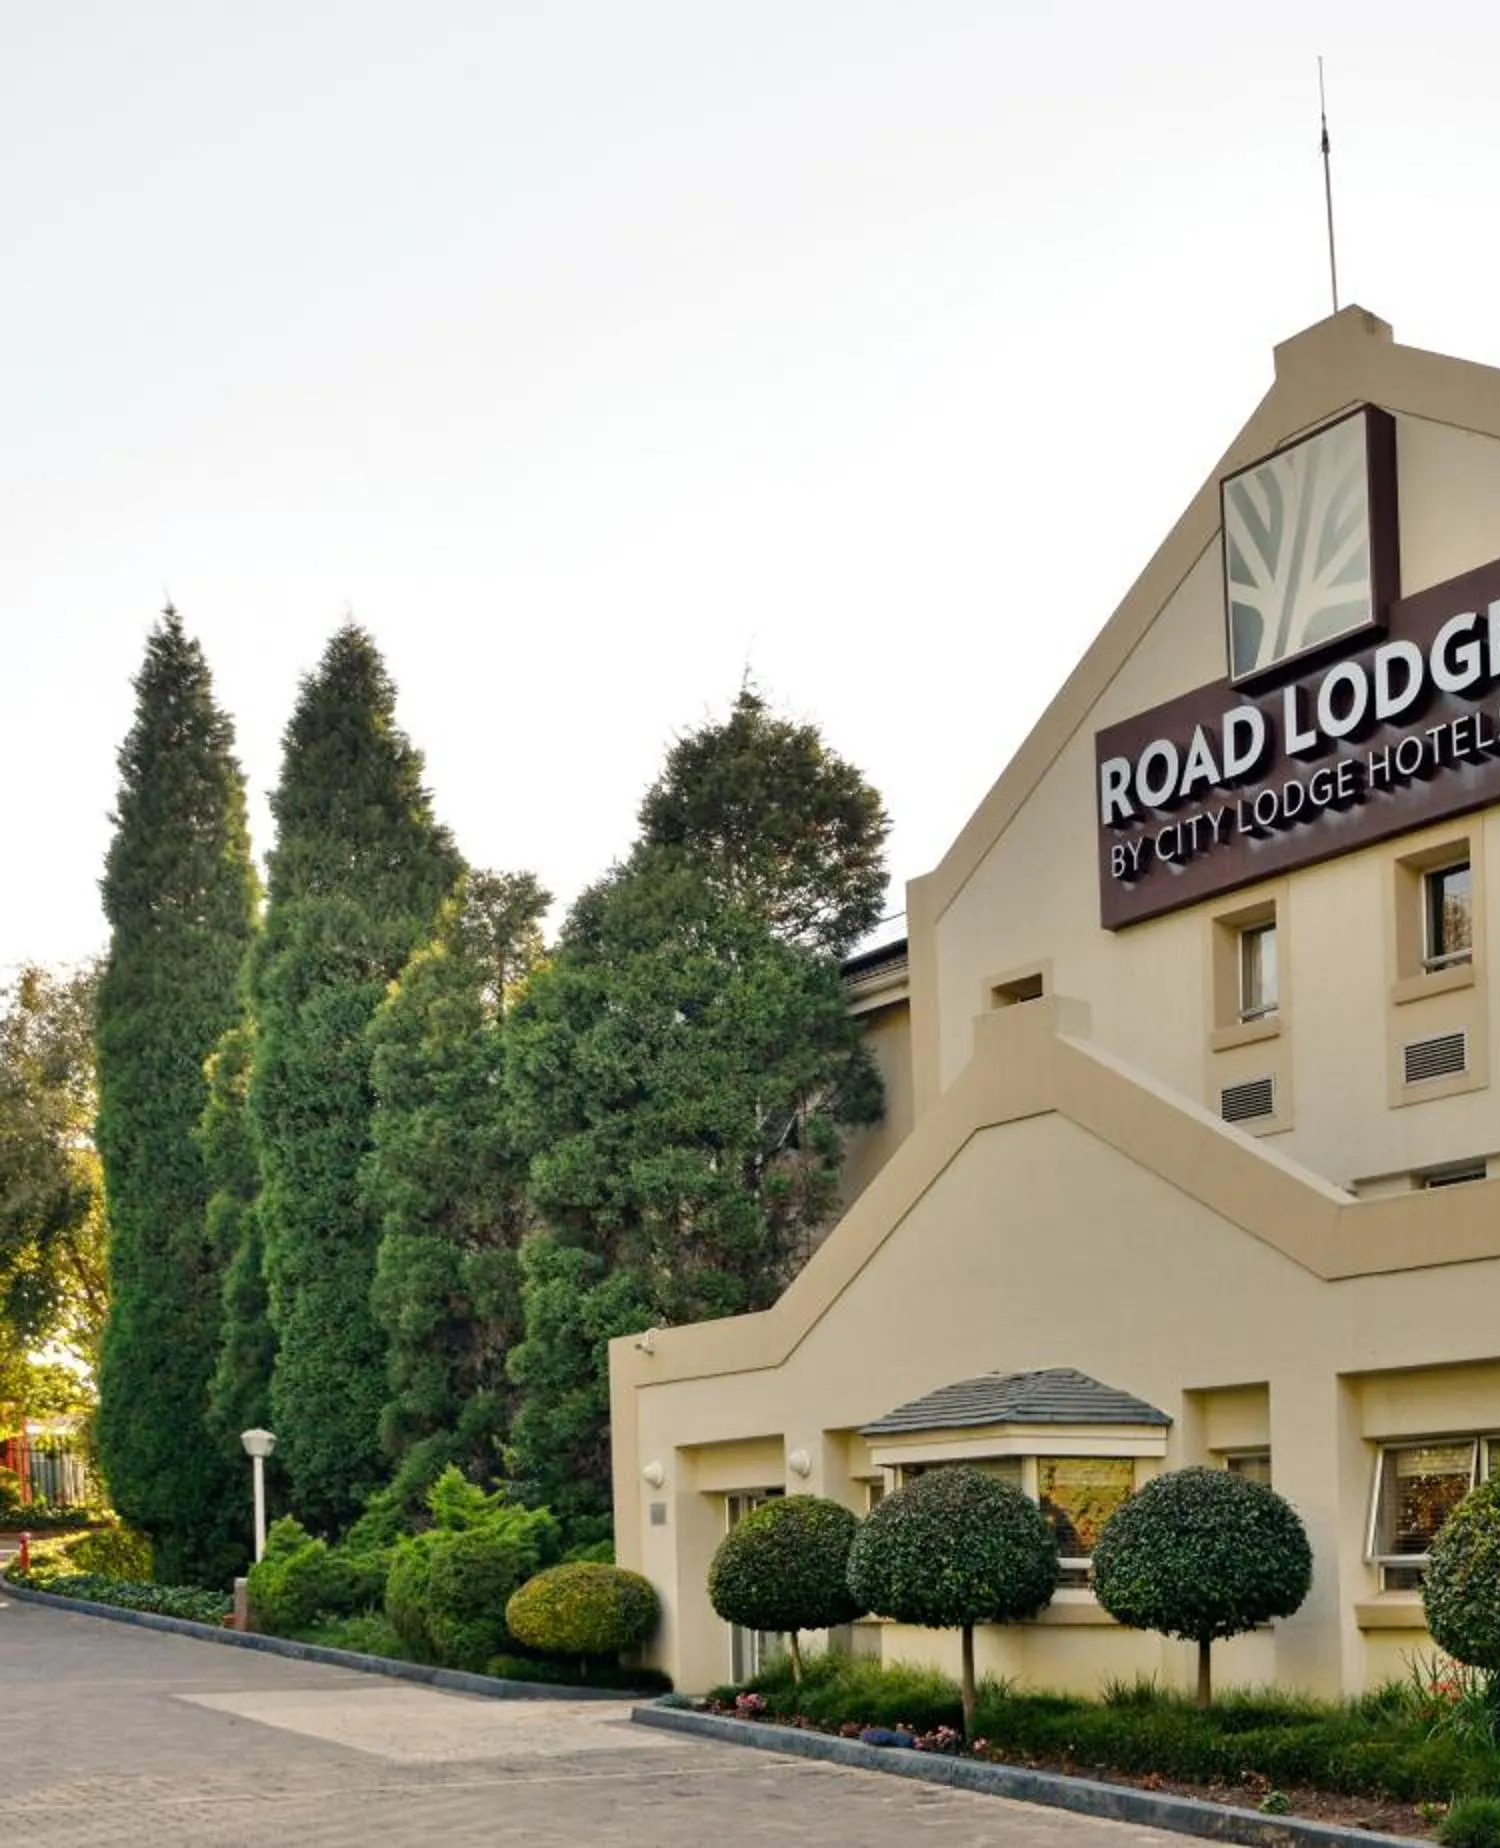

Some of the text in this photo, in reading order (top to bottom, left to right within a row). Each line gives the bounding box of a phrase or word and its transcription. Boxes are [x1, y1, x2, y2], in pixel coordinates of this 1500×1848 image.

[1101, 704, 1266, 826] ROAD
[1111, 838, 1142, 879] BY
[1155, 805, 1225, 863] CITY
[1237, 758, 1356, 834] LODGE
